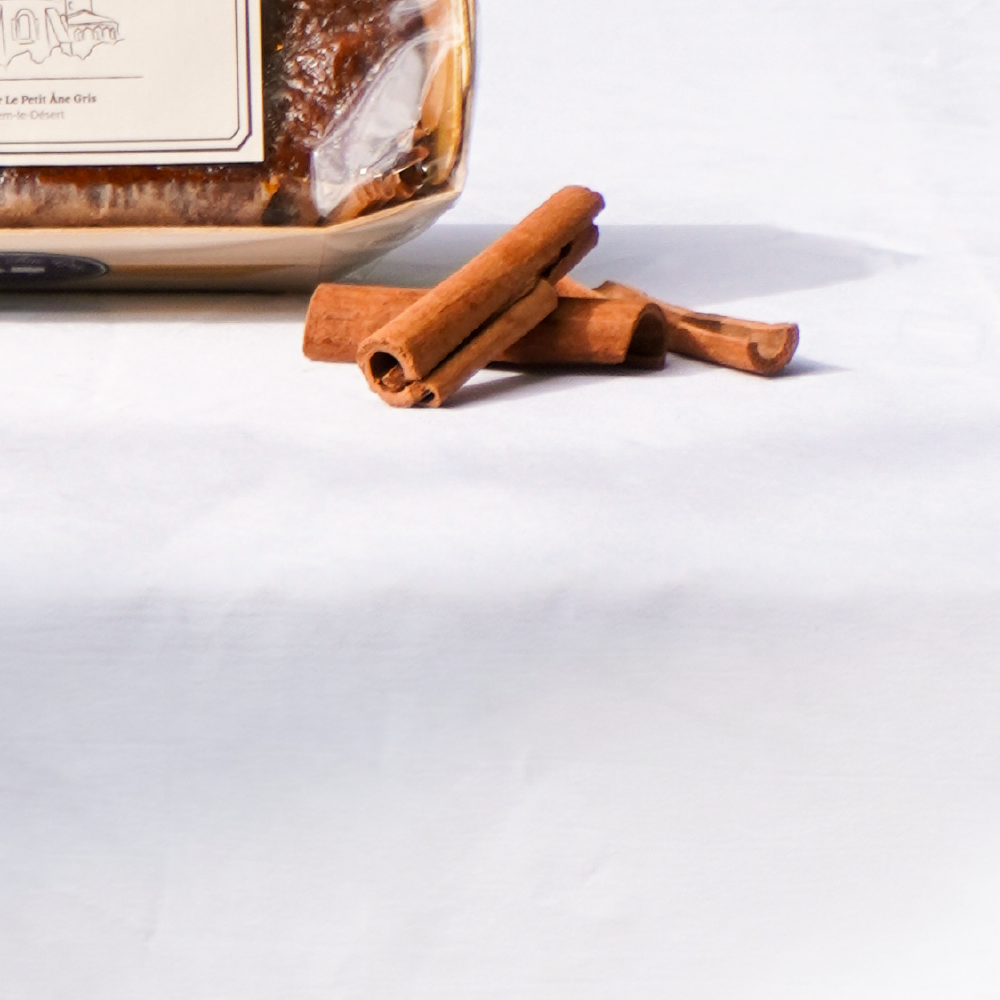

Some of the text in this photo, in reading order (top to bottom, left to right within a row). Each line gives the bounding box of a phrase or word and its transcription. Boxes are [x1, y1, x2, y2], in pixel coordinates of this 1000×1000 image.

[5, 95, 19, 105] Le
[21, 94, 46, 105] Petit
[73, 93, 98, 104] Gris
